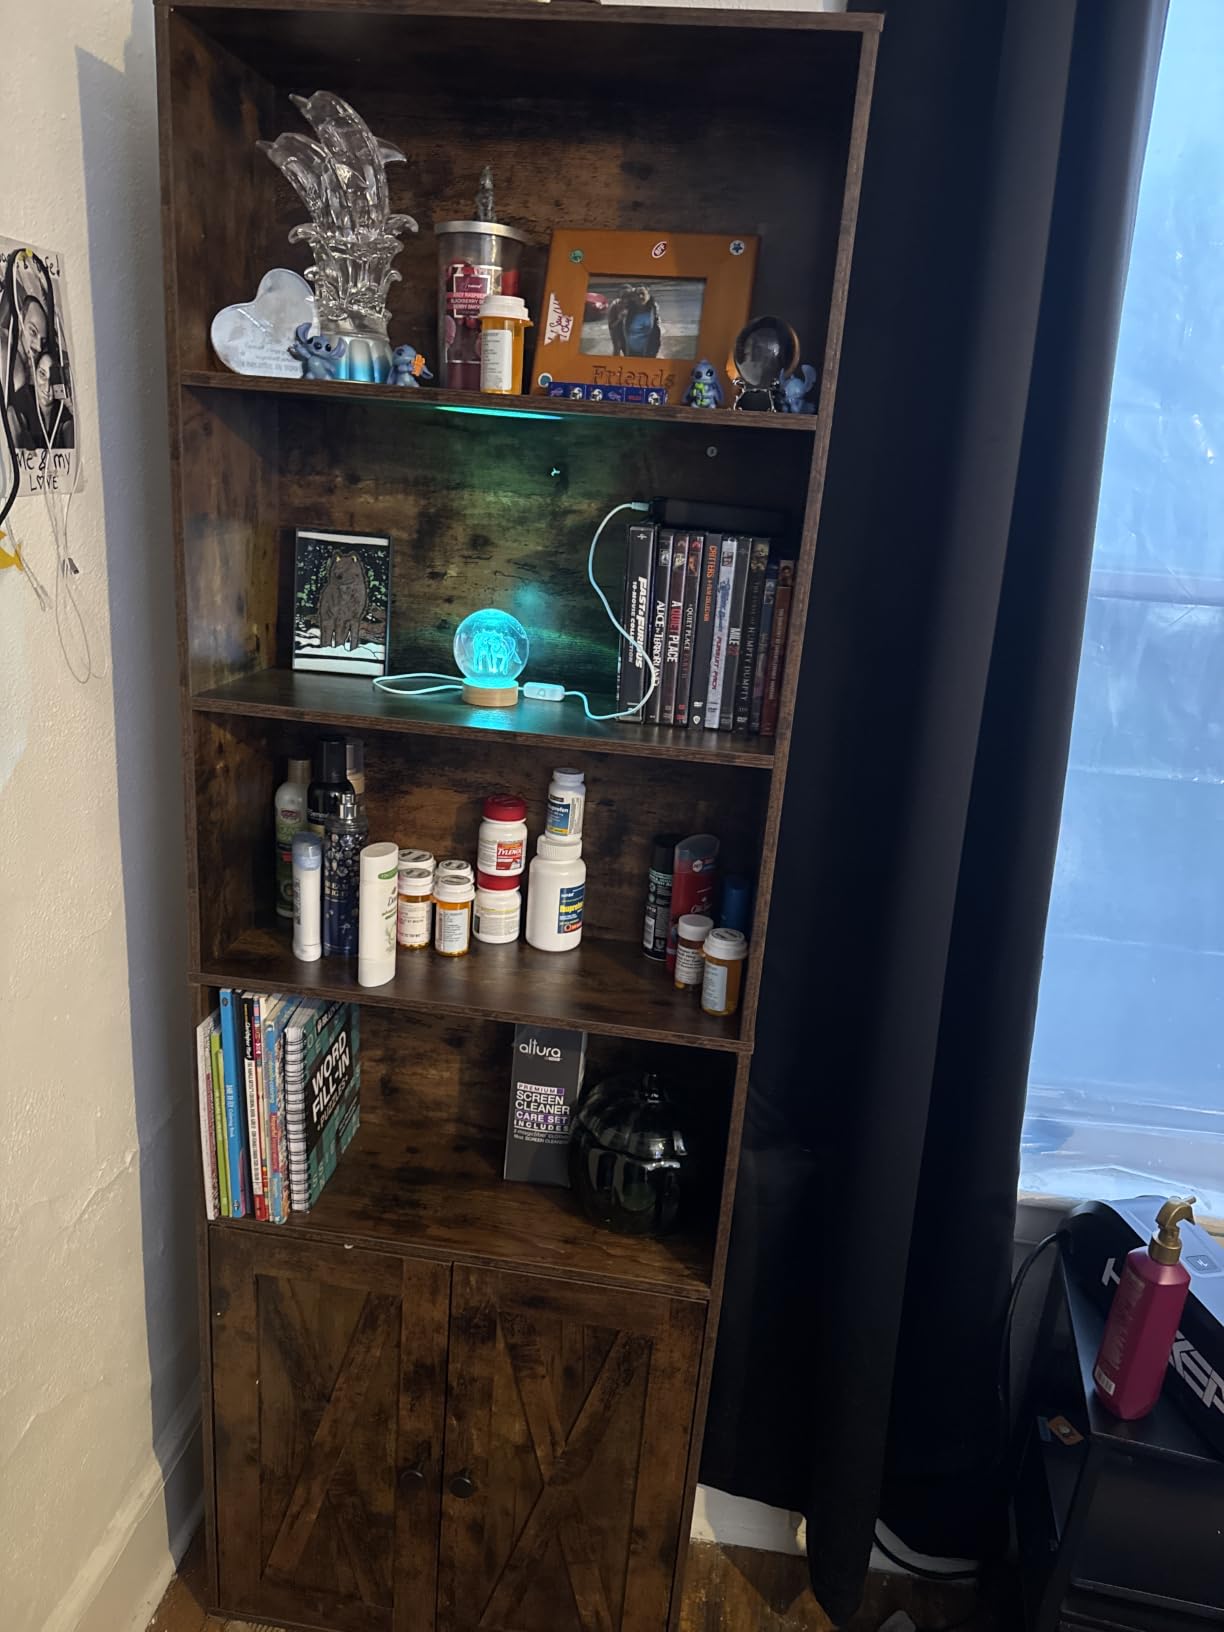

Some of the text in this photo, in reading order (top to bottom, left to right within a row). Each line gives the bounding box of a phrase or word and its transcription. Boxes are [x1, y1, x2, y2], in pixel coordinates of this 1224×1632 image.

[592, 365, 677, 390] Friends
[54, 453, 71, 475] my
[706, 545, 718, 578] CRITTERS
[655, 600, 666, 627] ALICE
[670, 607, 681, 634] QUIET
[686, 607, 694, 628] QUIET
[684, 629, 692, 650] PLACE
[729, 627, 741, 646] MILE
[745, 627, 755, 665] HUMPTY
[667, 635, 679, 662] PLACE
[741, 666, 751, 701] DUMPTY
[519, 1038, 562, 1058] altura
[312, 1031, 347, 1096] WORD
[312, 1047, 350, 1124] FILL-IN
[518, 1083, 557, 1095] PREMIUM
[515, 1100, 570, 1115] CLEANER
[516, 1091, 564, 1105] SCREEN
[514, 1120, 569, 1132] INCLUDES
[516, 1111, 568, 1124] CARE SET
